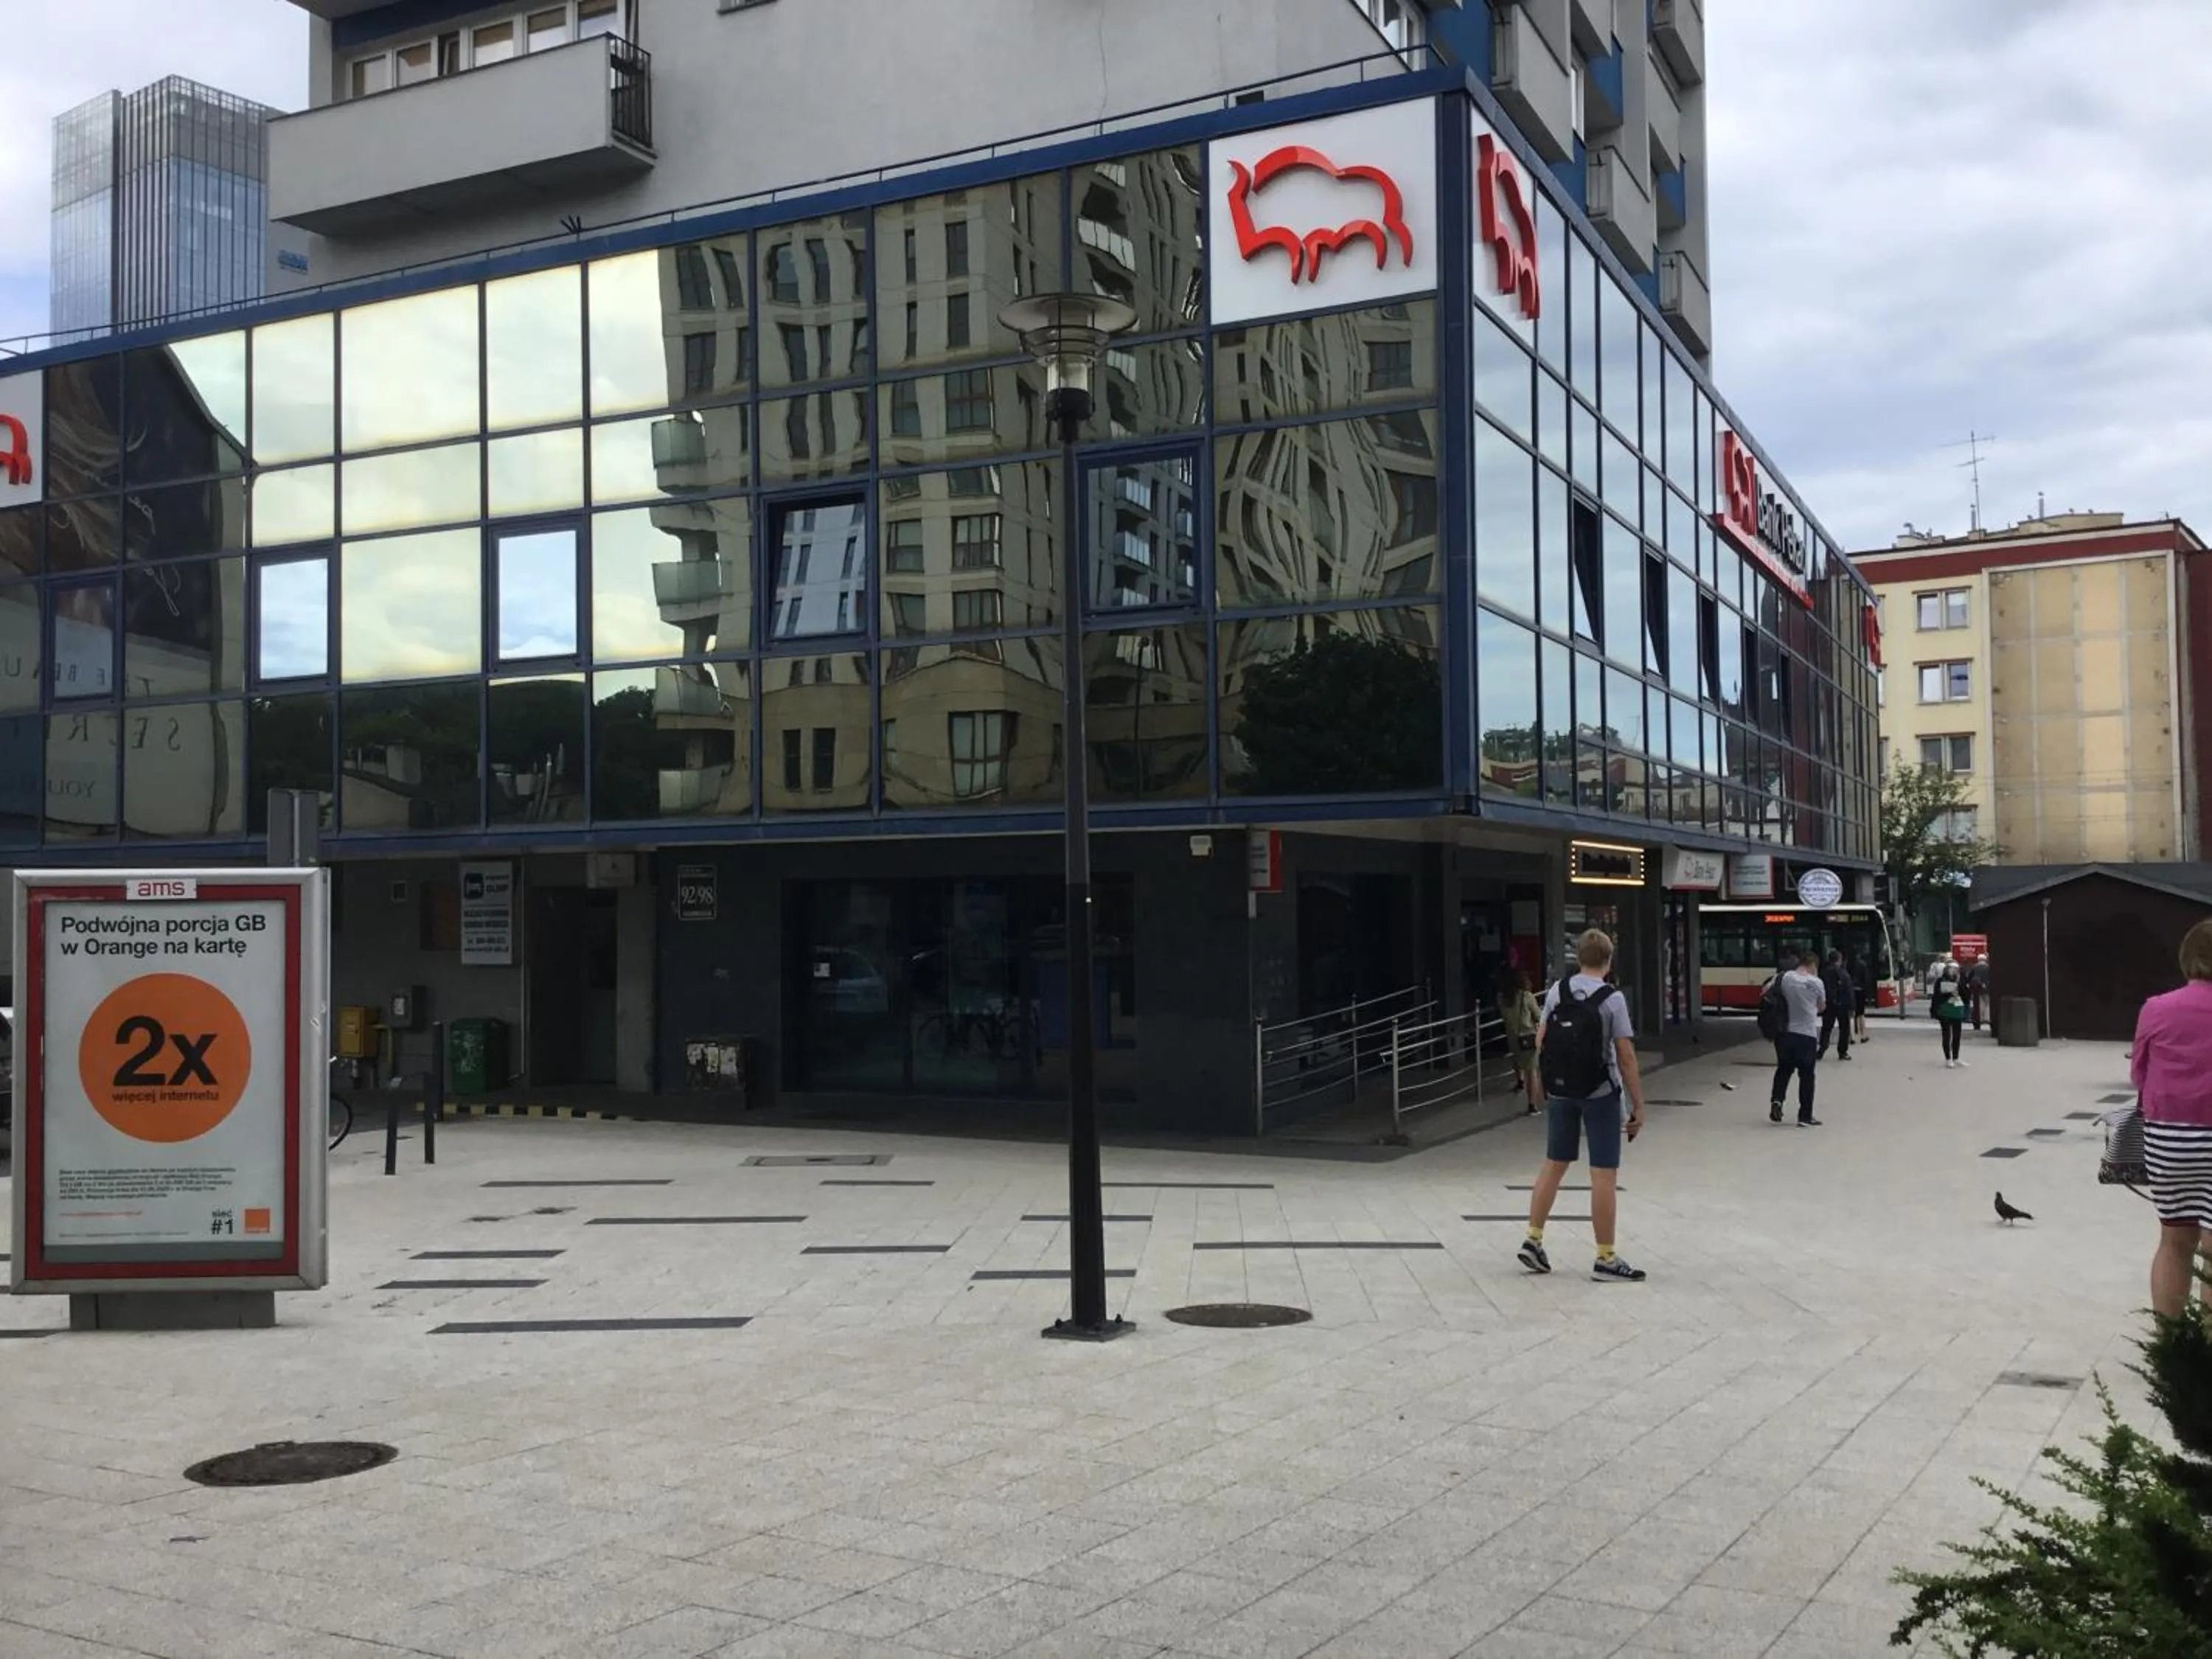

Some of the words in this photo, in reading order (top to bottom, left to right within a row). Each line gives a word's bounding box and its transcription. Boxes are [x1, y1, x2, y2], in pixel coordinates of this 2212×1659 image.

[138, 882, 185, 897] ams
[61, 916, 160, 936] Podwójna
[166, 916, 229, 935] porcja
[235, 914, 266, 931] GB
[61, 942, 78, 955] w
[85, 938, 159, 959] Orange
[164, 942, 188, 954] na
[195, 937, 246, 957] kartę
[113, 1015, 218, 1086] 2x
[212, 1219, 234, 1235] #1
